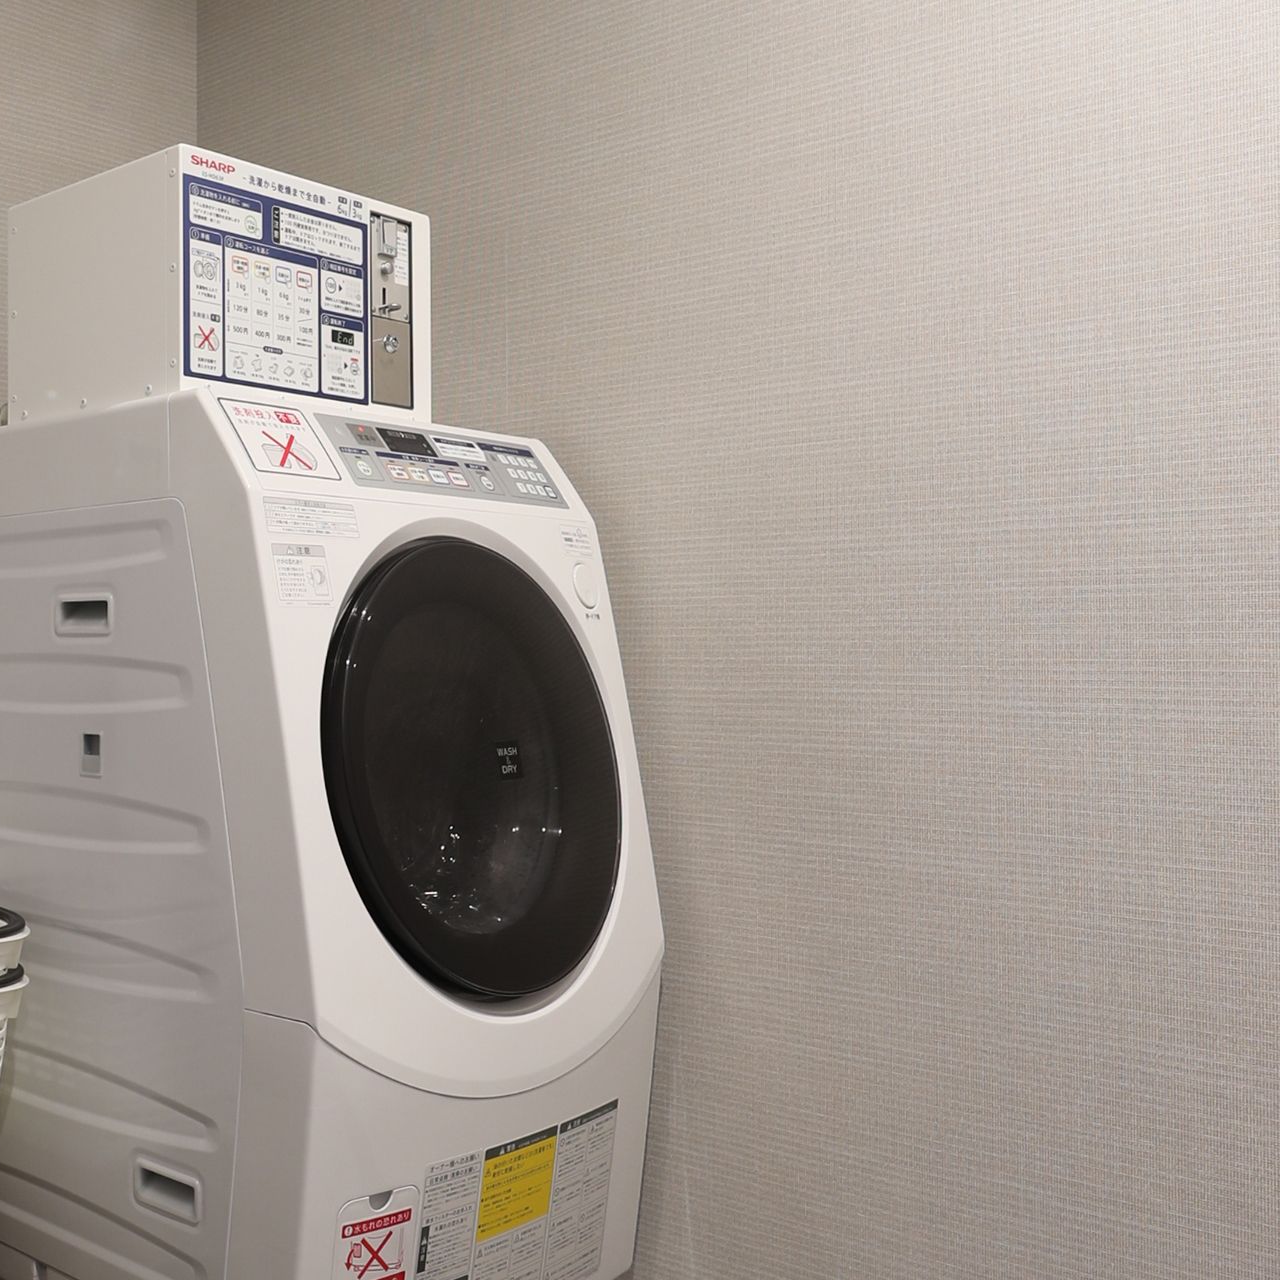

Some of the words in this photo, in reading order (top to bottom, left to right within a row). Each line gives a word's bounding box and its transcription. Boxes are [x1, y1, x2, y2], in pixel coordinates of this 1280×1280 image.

[190, 154, 235, 174] SHARP
[496, 747, 518, 756] WASH
[501, 765, 517, 774] DRY
[353, 1211, 410, 1234] 水もれの恐れあり
